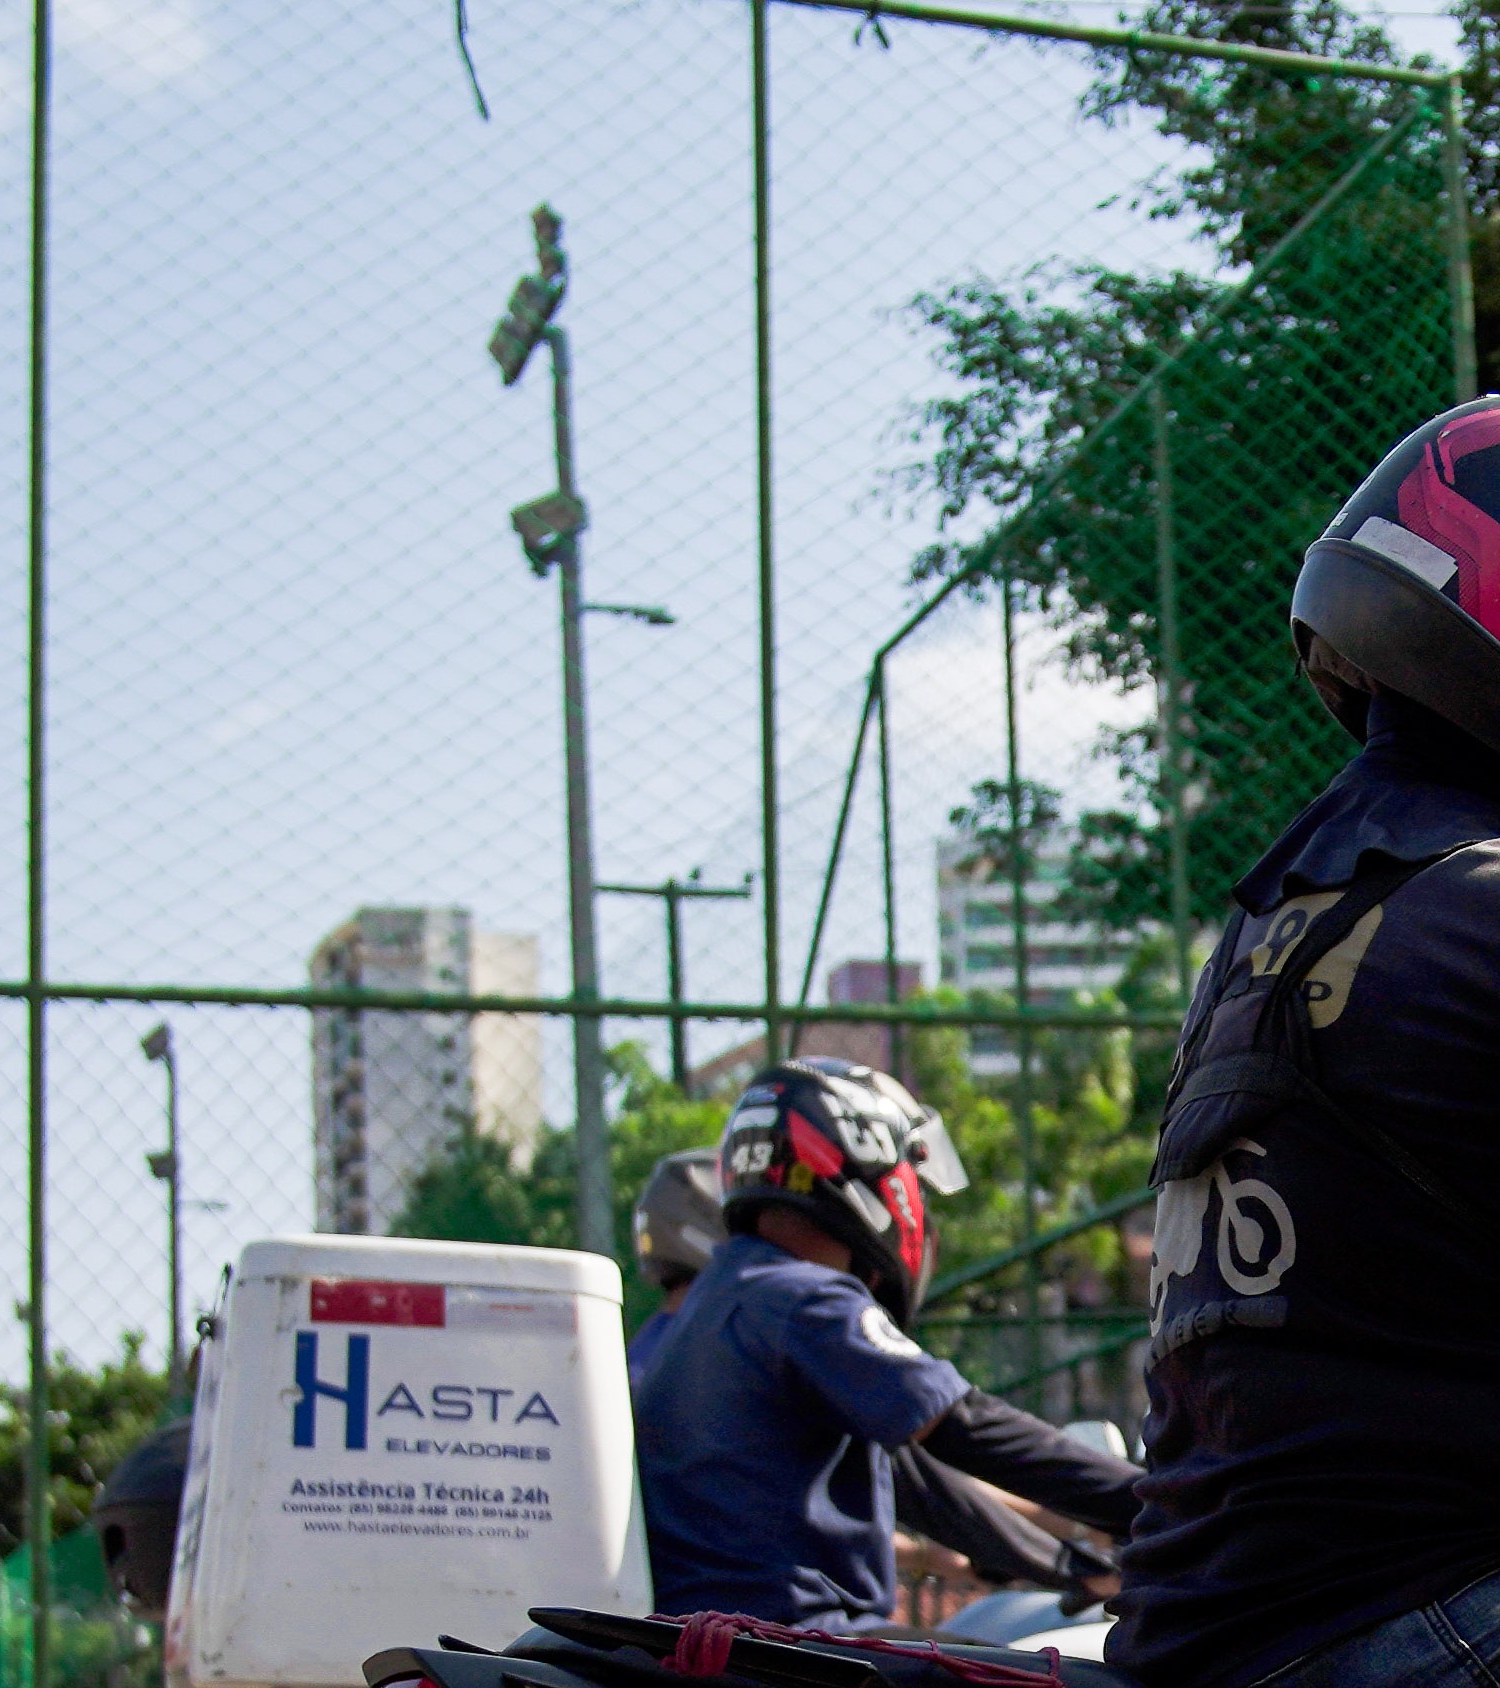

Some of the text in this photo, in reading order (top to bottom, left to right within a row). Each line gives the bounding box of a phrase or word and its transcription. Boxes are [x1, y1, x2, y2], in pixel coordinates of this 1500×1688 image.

[291, 1329, 561, 1451] HASTA
[387, 1437, 551, 1462] ELEVADORES
[290, 1478, 549, 1505] Assistência Técnica 24h
